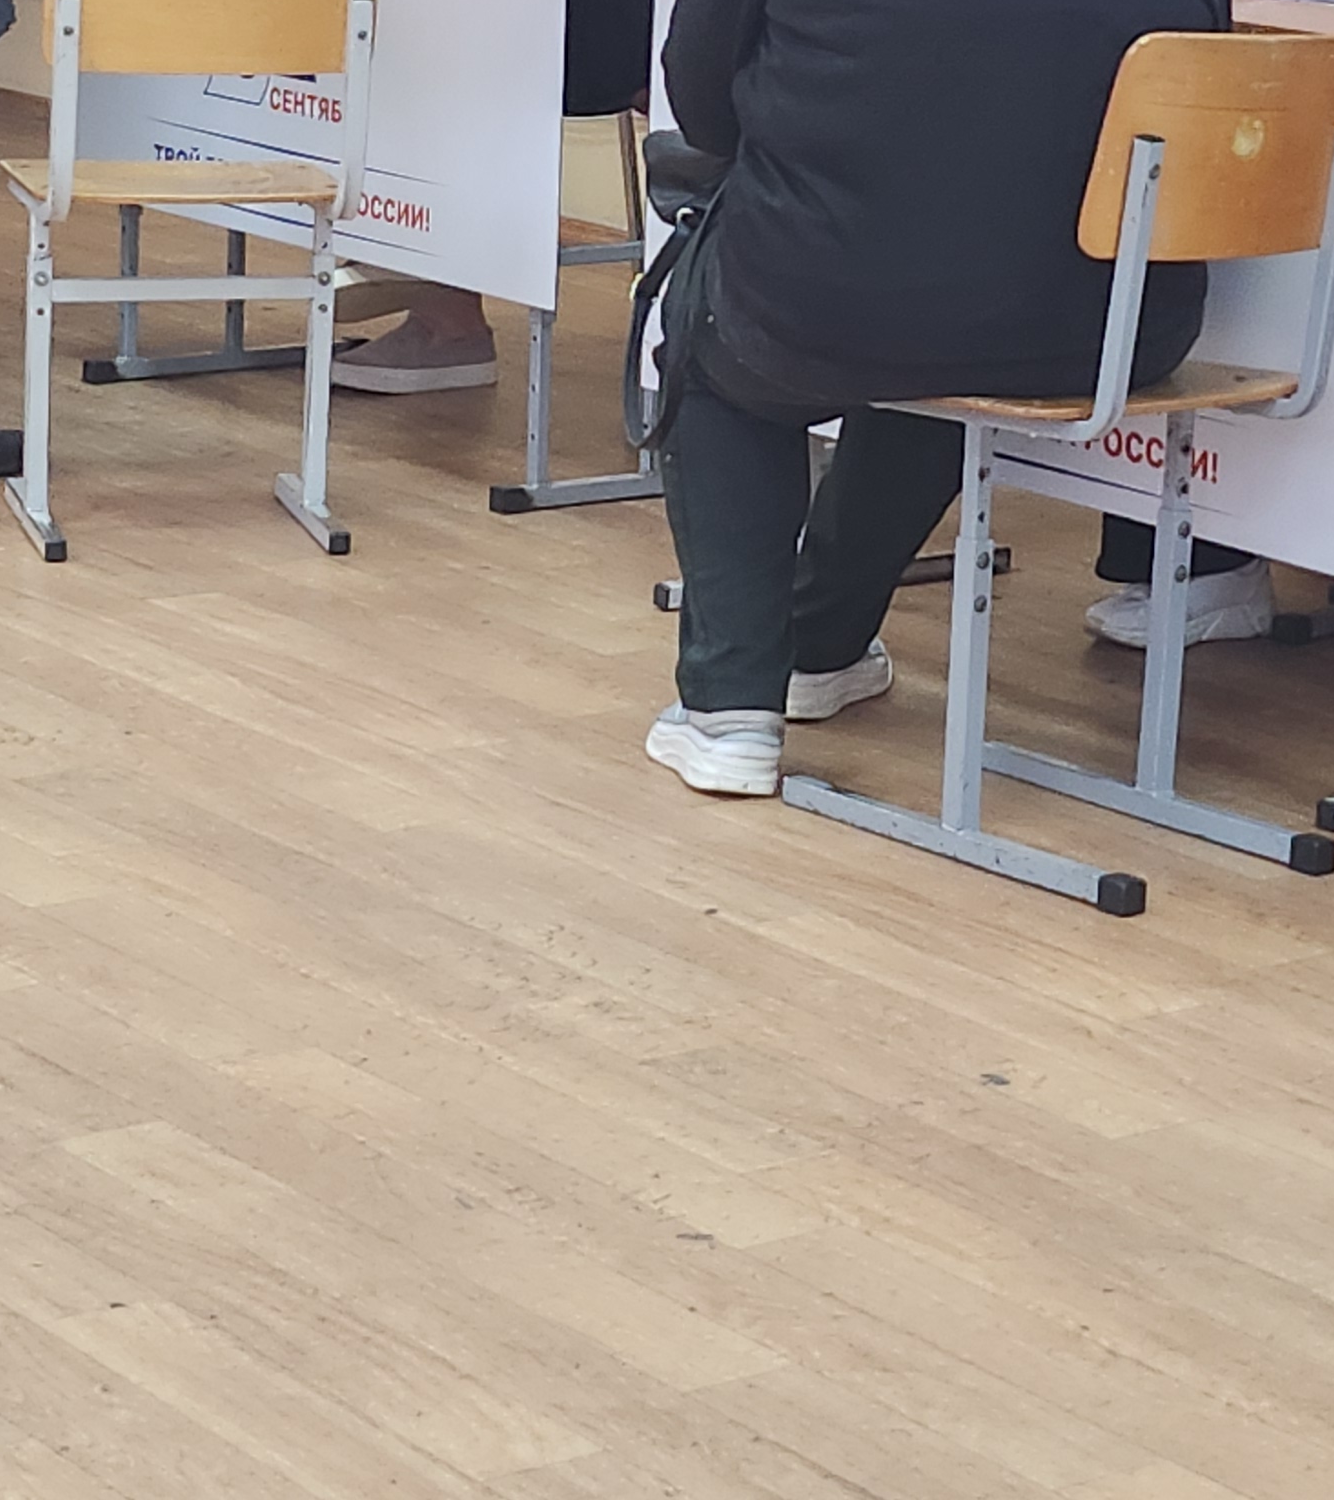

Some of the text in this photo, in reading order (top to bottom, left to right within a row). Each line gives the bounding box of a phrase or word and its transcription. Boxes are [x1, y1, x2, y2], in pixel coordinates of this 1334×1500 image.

[269, 86, 343, 123] СЕНТЯБ
[357, 190, 431, 233] ОССИИ!
[1084, 426, 1219, 485] ОССИ!
